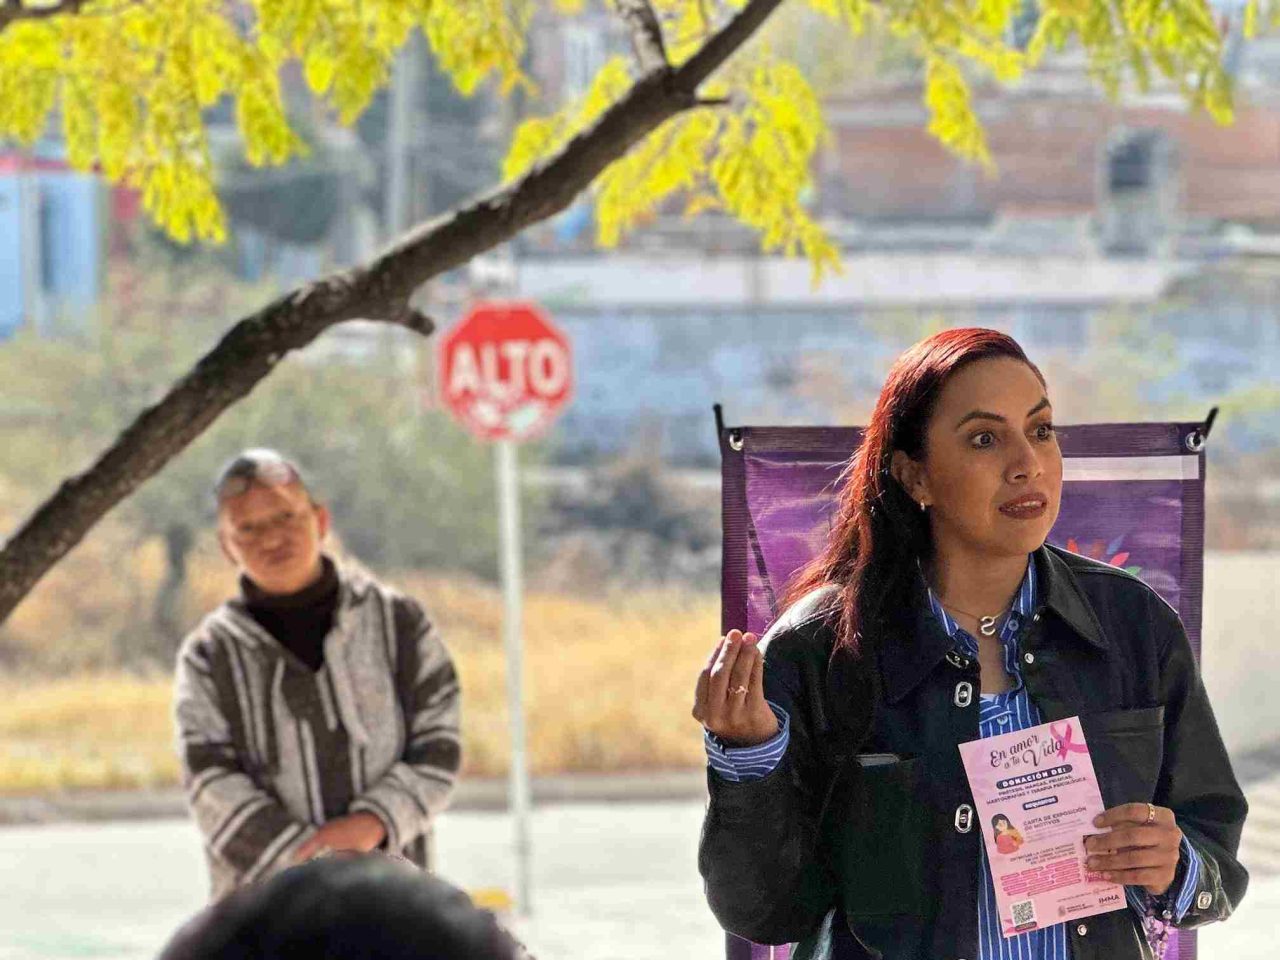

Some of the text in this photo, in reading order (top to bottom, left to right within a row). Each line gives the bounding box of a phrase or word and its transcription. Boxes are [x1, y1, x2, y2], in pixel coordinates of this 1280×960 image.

[449, 339, 568, 398] ALTO
[990, 734, 1039, 768] En amor
[1022, 737, 1065, 767] Vida
[1002, 767, 1066, 788] DONACIÓN DE:
[1023, 817, 1042, 826] CARTA
[1052, 807, 1087, 819] EXPOSICIÓN
[1098, 894, 1120, 904] IMMA
